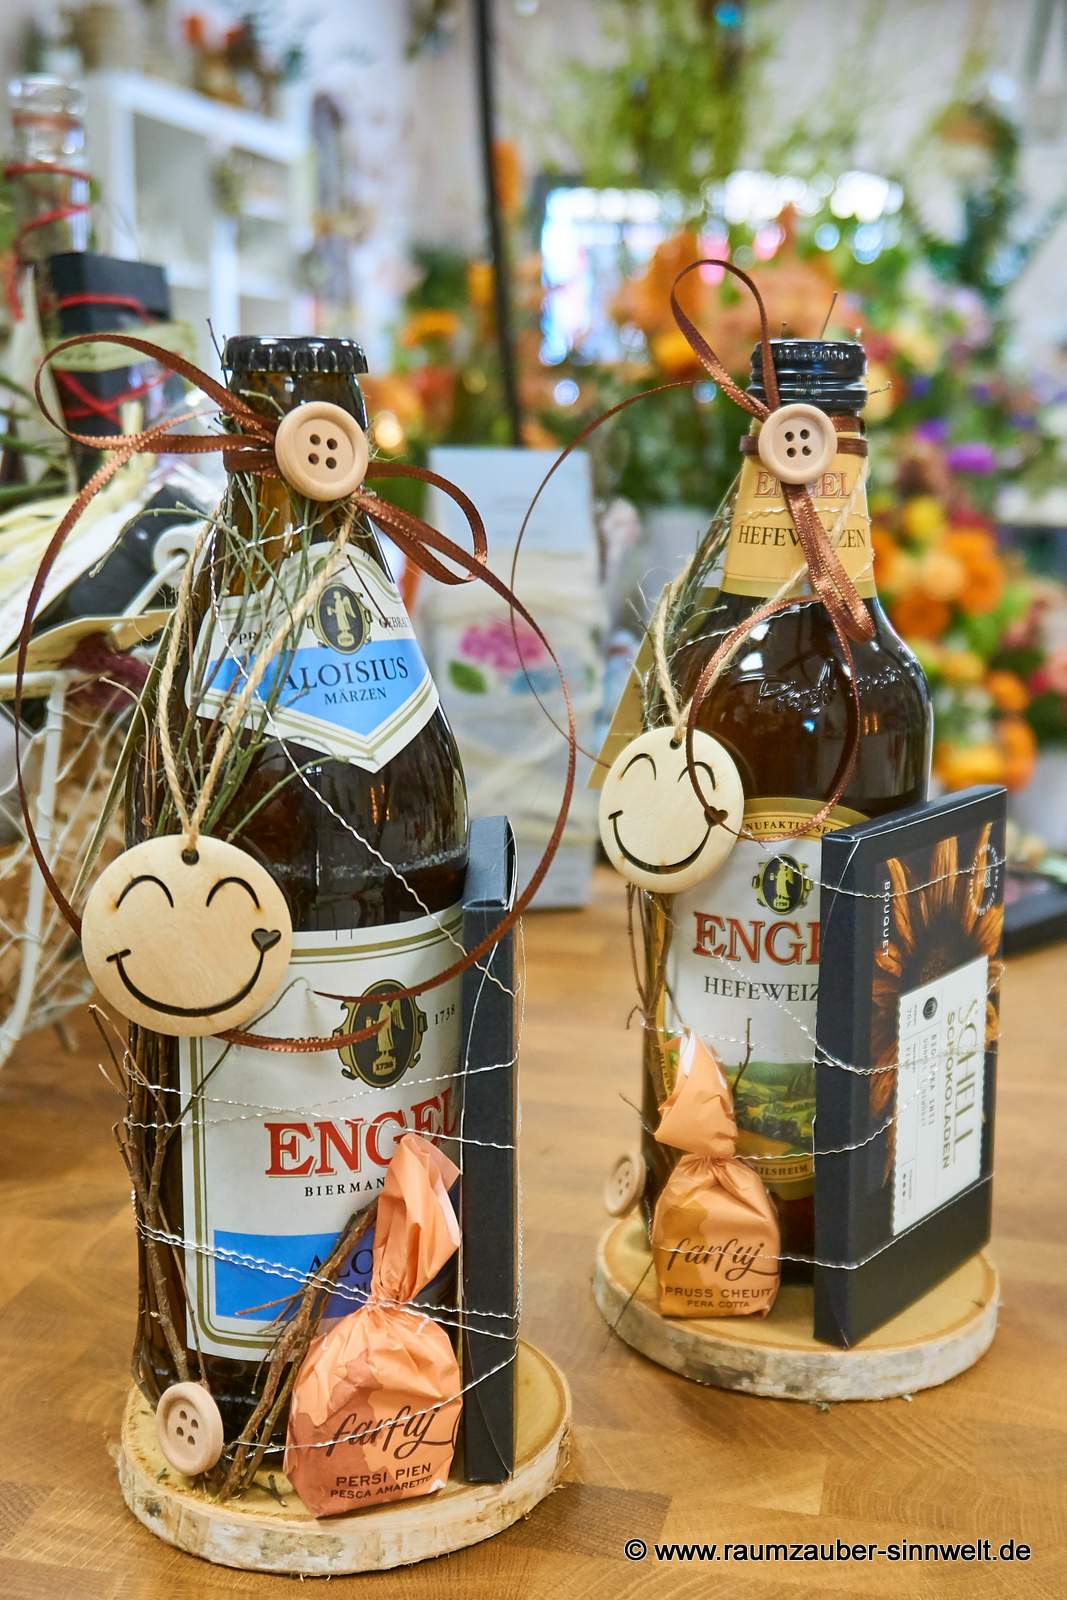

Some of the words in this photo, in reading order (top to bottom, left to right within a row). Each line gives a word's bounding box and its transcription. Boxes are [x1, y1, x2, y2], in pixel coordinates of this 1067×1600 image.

[754, 471, 850, 499] EEL
[282, 656, 409, 691] ALOISIUS
[323, 686, 388, 706] MÄRZEN
[882, 881, 891, 957] BOUQUET
[264, 1087, 459, 1179] ENGEL
[665, 1287, 714, 1298] PRUSS
[687, 1300, 714, 1308] PERA
[330, 1488, 371, 1500] PESCA
[375, 1475, 433, 1495] AMARETTO
[336, 1472, 387, 1487] PERSI
[395, 1463, 431, 1480] PIEN
